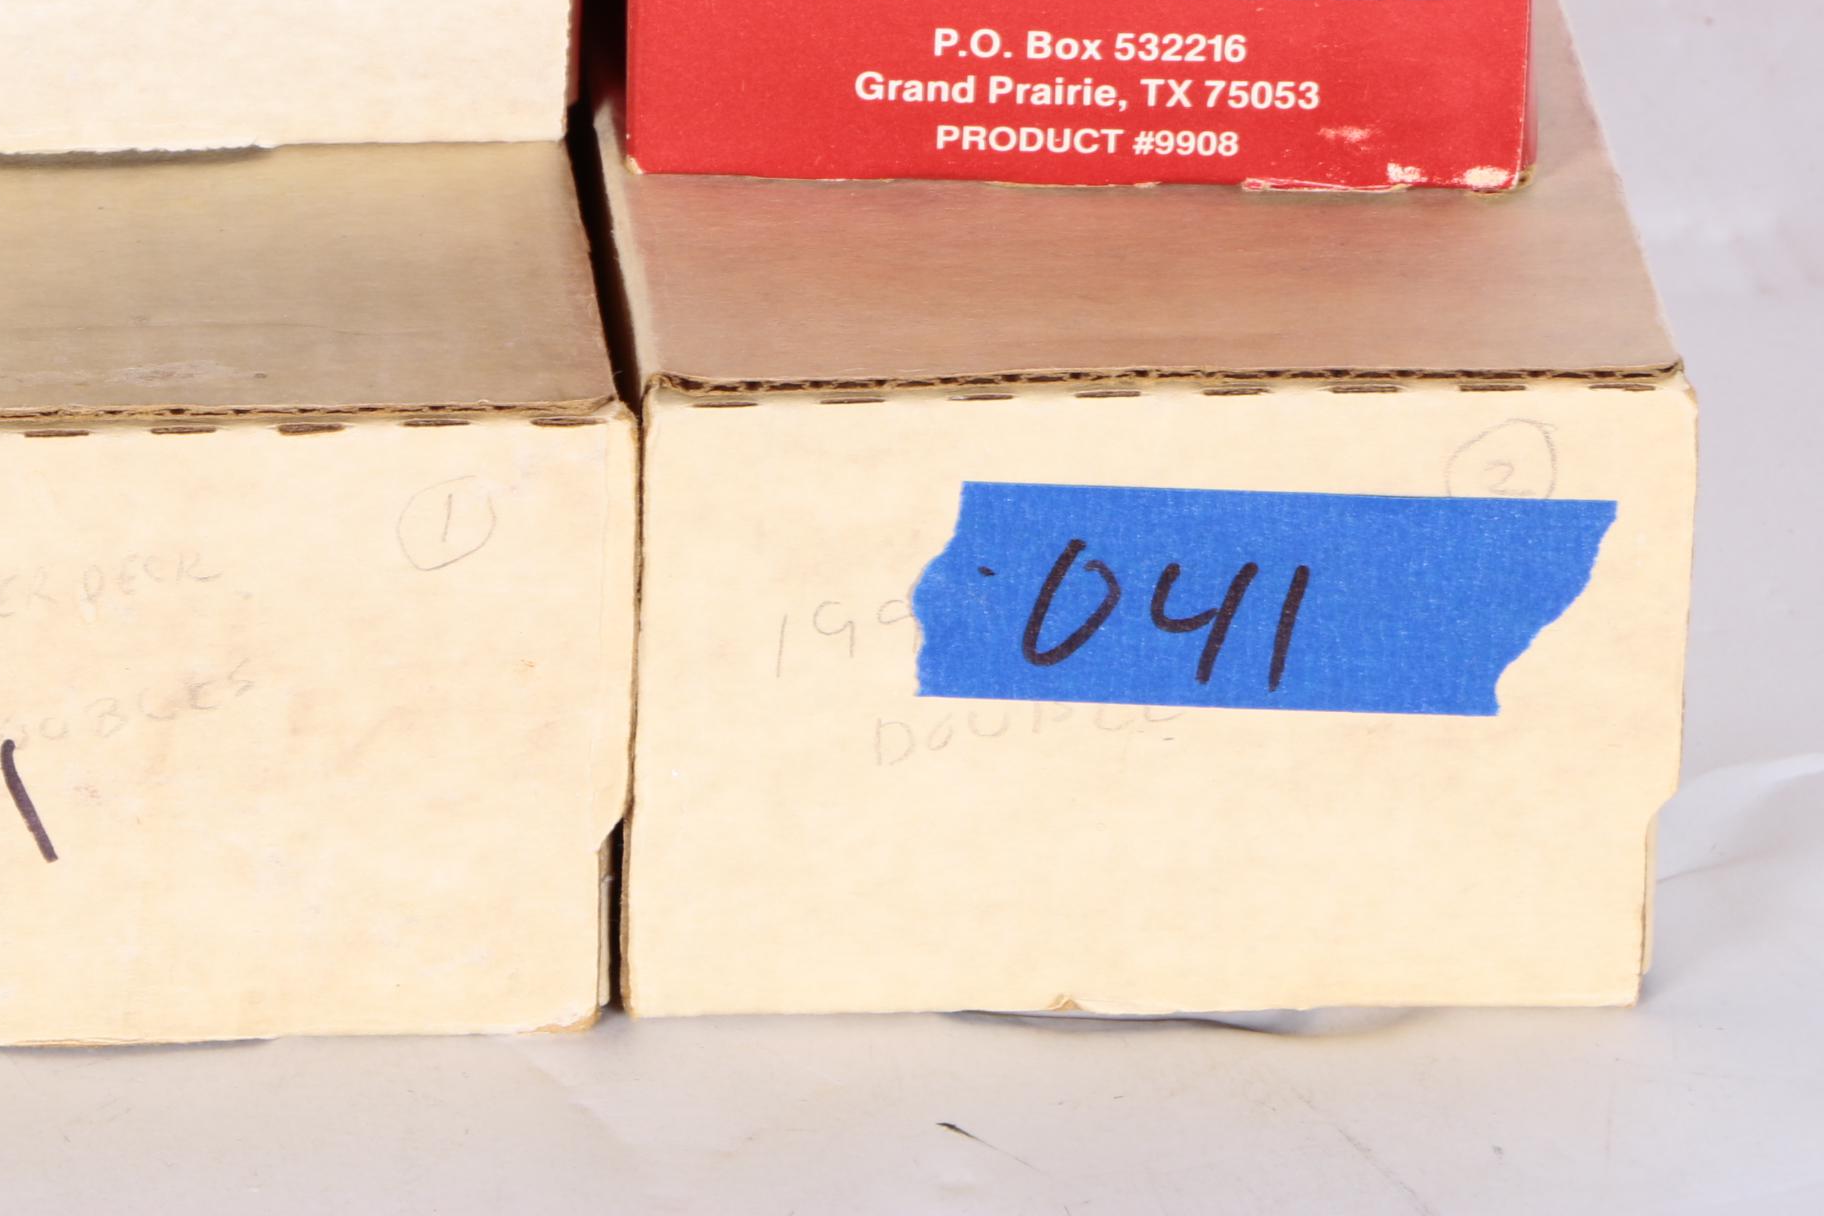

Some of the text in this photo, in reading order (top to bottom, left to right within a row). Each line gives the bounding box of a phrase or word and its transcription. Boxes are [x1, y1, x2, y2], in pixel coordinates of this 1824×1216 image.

[933, 27, 1247, 64] P.O. Box 532216
[854, 71, 1320, 112] Grand Prairie, TX 75053
[935, 125, 1240, 157] PRODUCT #9908
[1020, 536, 1312, 694] 041
